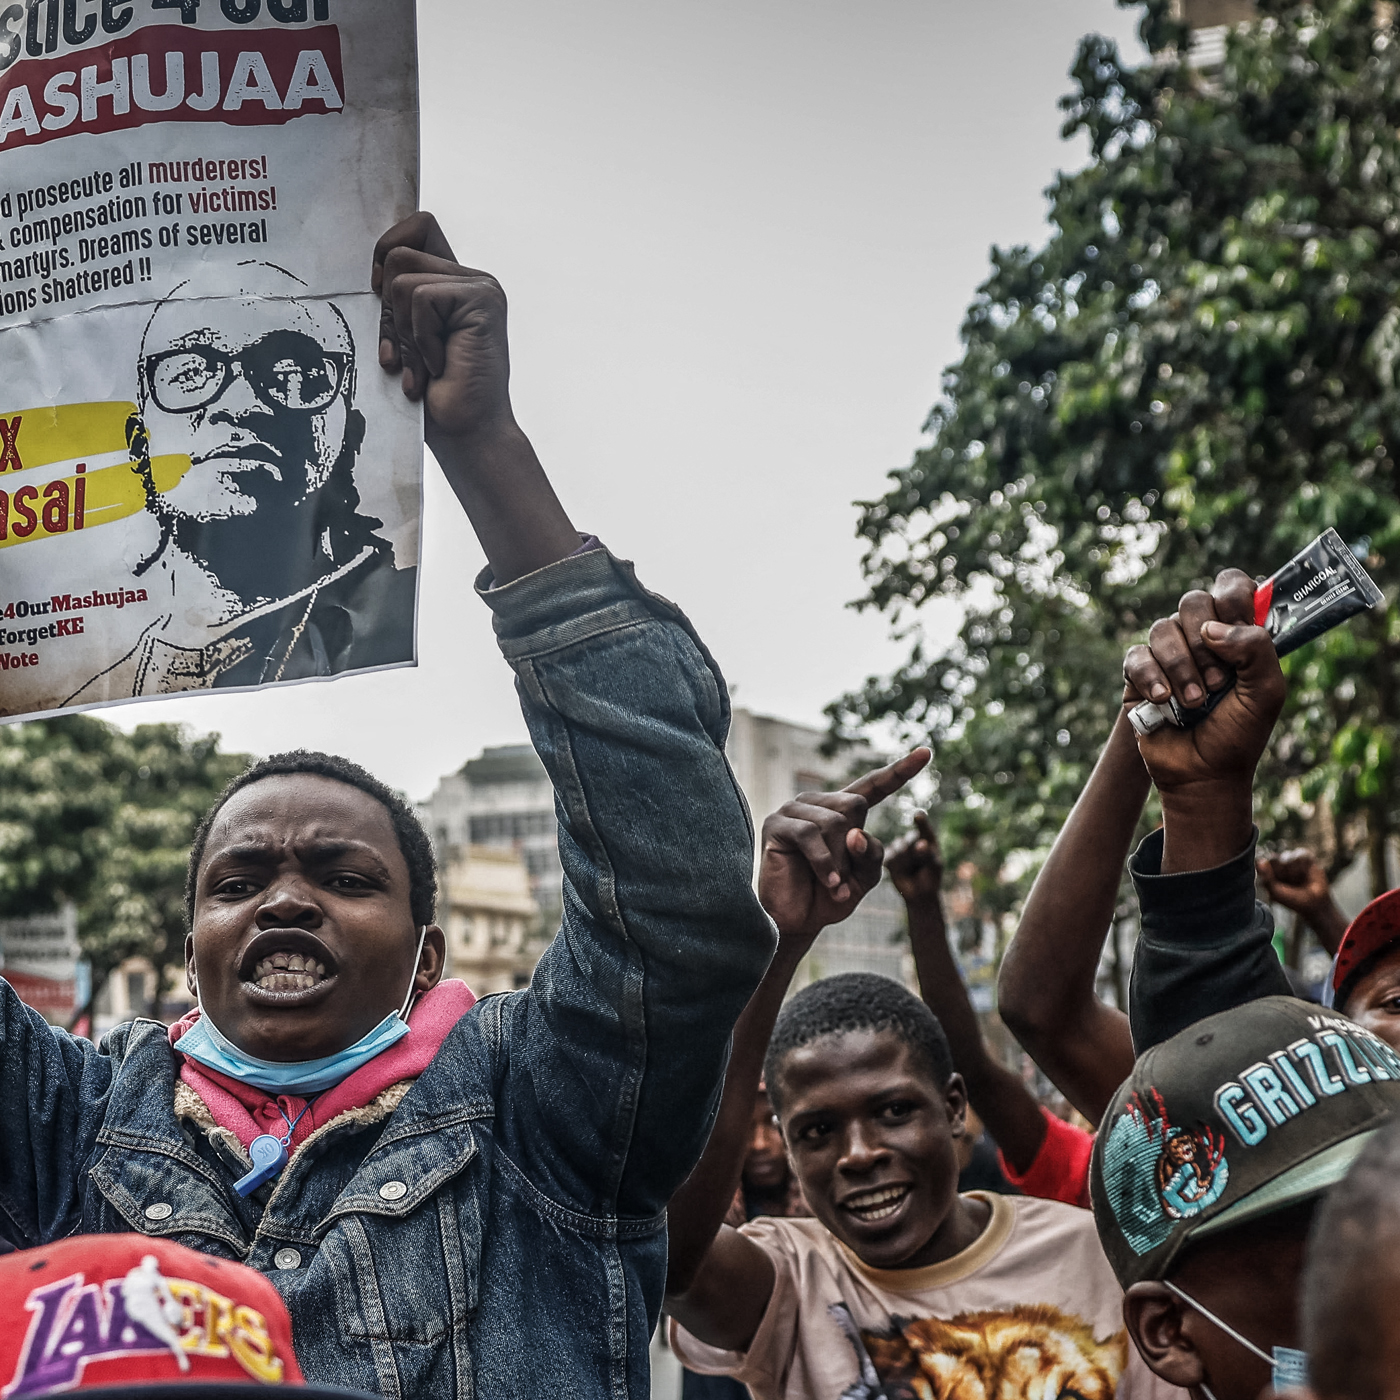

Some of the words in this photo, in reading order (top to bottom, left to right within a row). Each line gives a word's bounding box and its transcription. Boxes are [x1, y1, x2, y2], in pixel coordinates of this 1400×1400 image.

[17, 171, 113, 222] prosecute
[118, 161, 142, 189] all
[148, 155, 268, 184] murderers!
[10, 196, 147, 248] compensation
[152, 191, 183, 216] for
[188, 186, 277, 214] victims!
[79, 228, 152, 264] Dreams
[158, 222, 180, 247] of
[186, 218, 268, 246] several
[139, 256, 152, 282] !!
[1293, 566, 1337, 602] CHARCOAL
